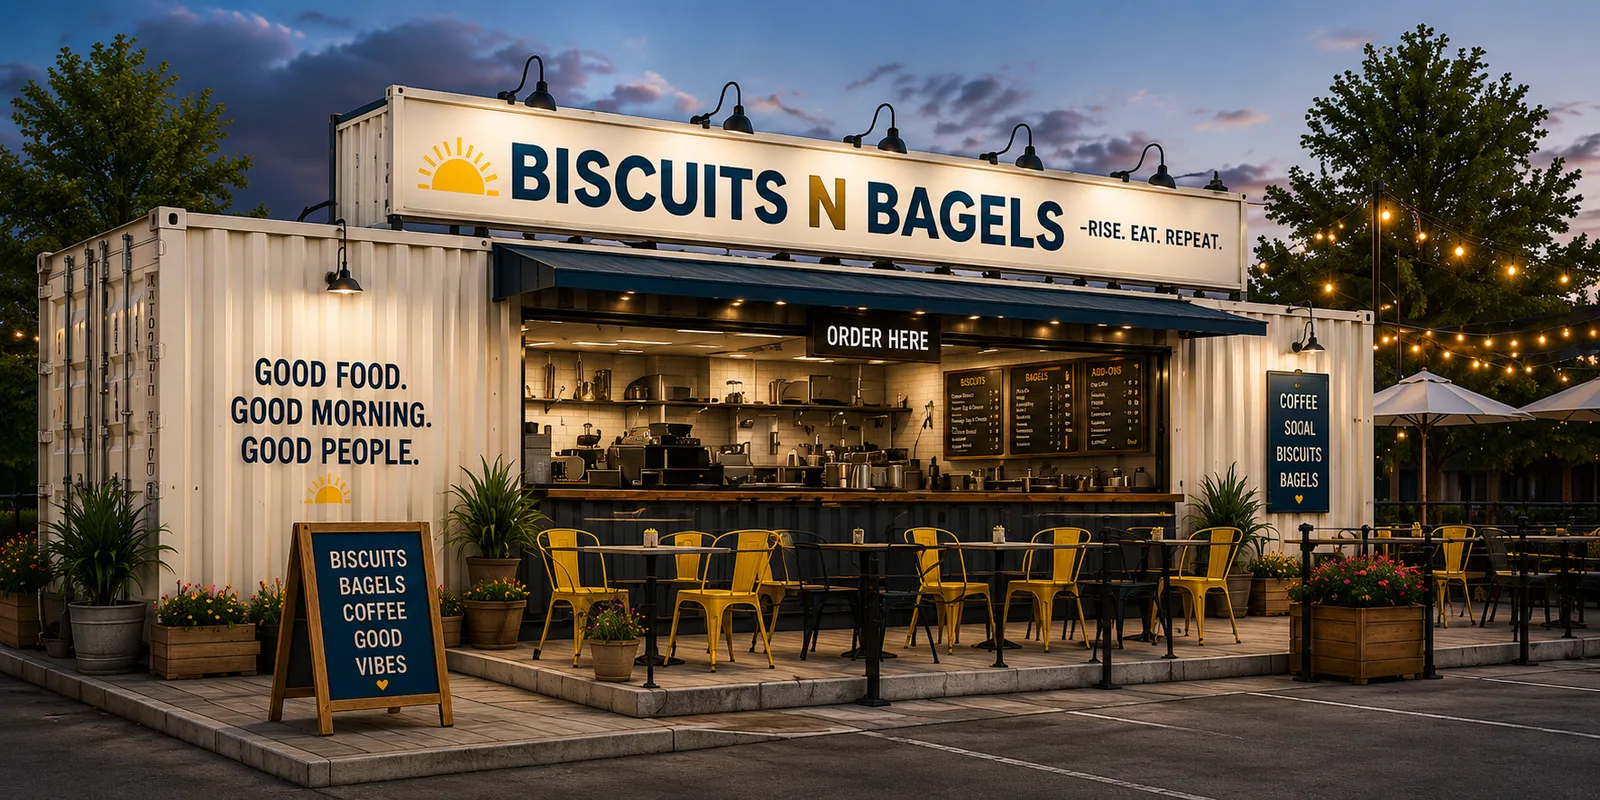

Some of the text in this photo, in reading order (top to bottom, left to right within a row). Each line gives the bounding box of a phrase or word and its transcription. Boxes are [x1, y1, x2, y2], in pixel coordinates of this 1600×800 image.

[510, 142, 1065, 252] BISCUITS N BAGELS
[1131, 224, 1161, 244] EAT.
[1165, 228, 1223, 251] REPEAT.
[827, 325, 929, 351] ORDER HERE
[255, 357, 407, 390] GOOD FOOD.
[231, 395, 432, 428] GOOD MORNING.
[1279, 392, 1318, 410] COFFEE
[241, 435, 419, 466] GOOD PEOPLE.
[1276, 446, 1322, 463] BISCUITS
[1280, 472, 1319, 488] BAGELS
[329, 549, 407, 569] BISCUITS
[339, 575, 406, 595] BAGELS
[343, 601, 408, 622] COFFEE
[354, 628, 402, 649] GOOD
[355, 654, 407, 676] VIBES
